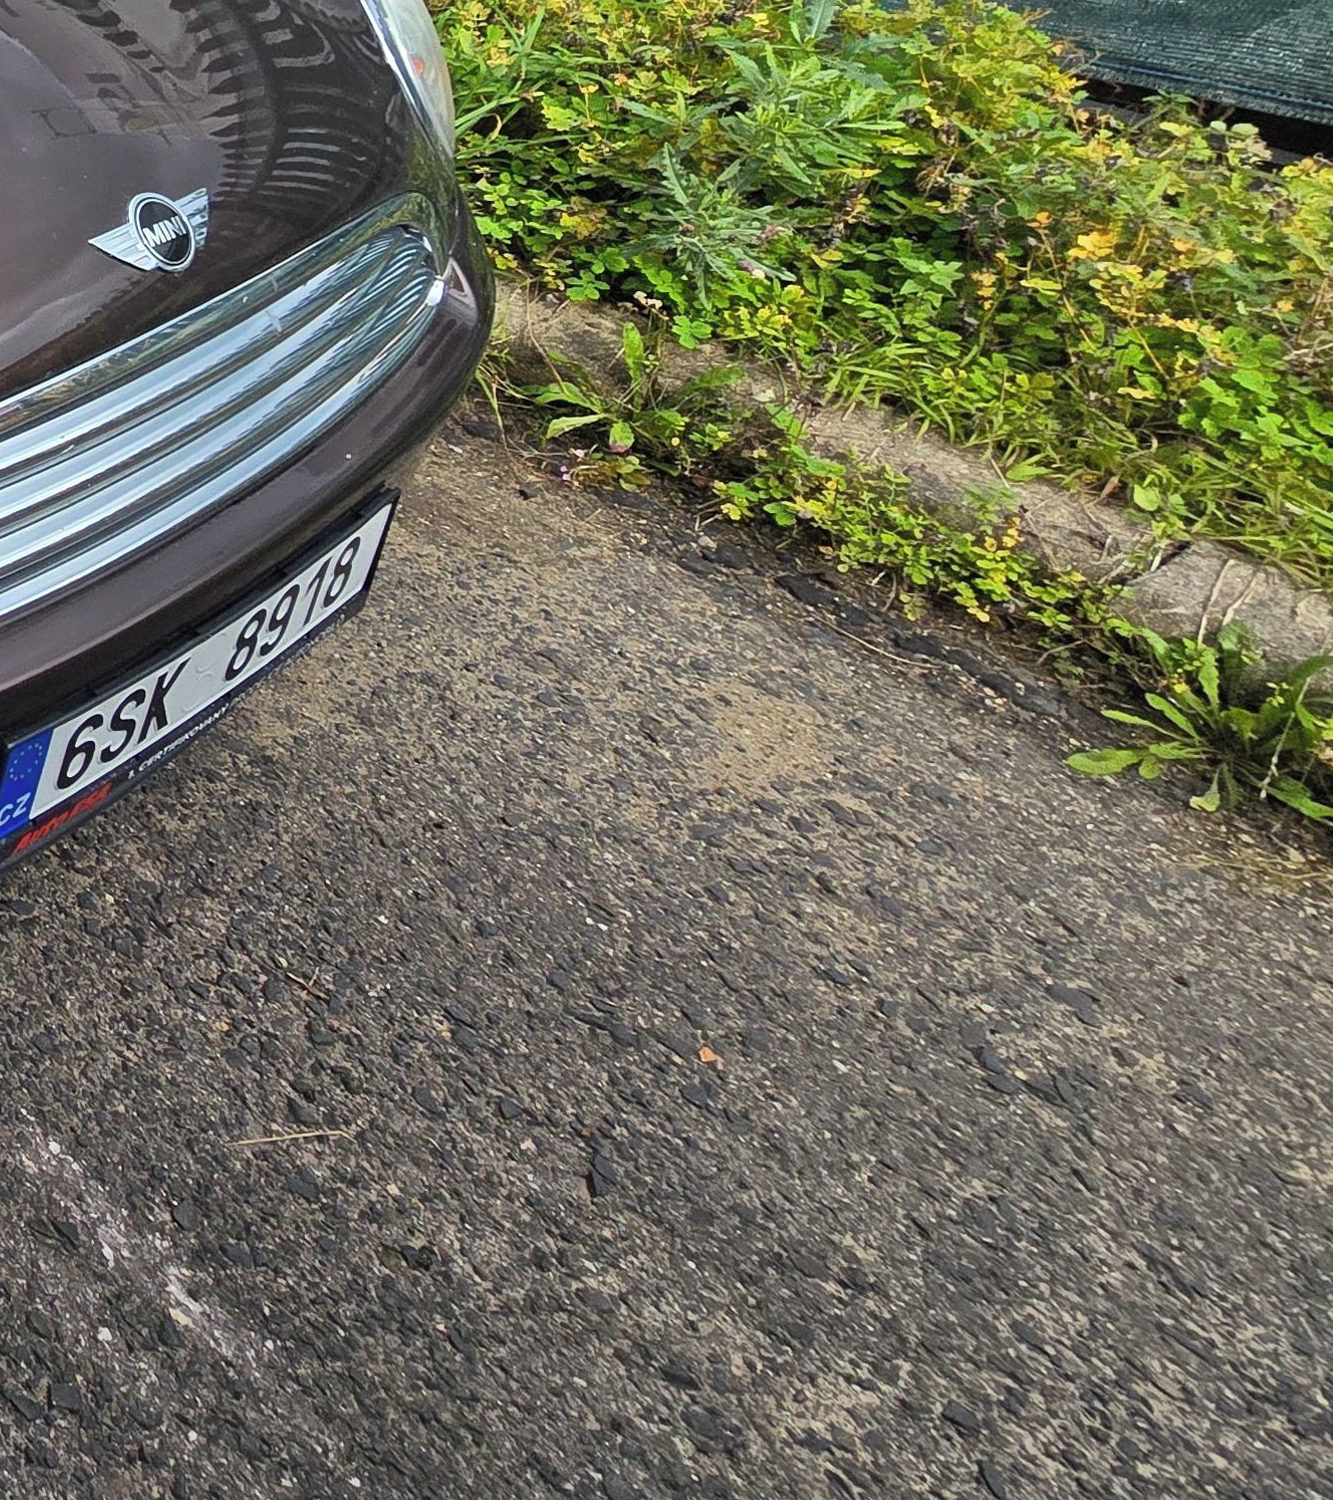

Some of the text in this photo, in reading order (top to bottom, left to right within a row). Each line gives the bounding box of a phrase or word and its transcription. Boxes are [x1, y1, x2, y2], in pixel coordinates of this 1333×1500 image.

[142, 215, 187, 248] MINI
[56, 658, 191, 790] 6SK
[224, 536, 362, 682] 8918
